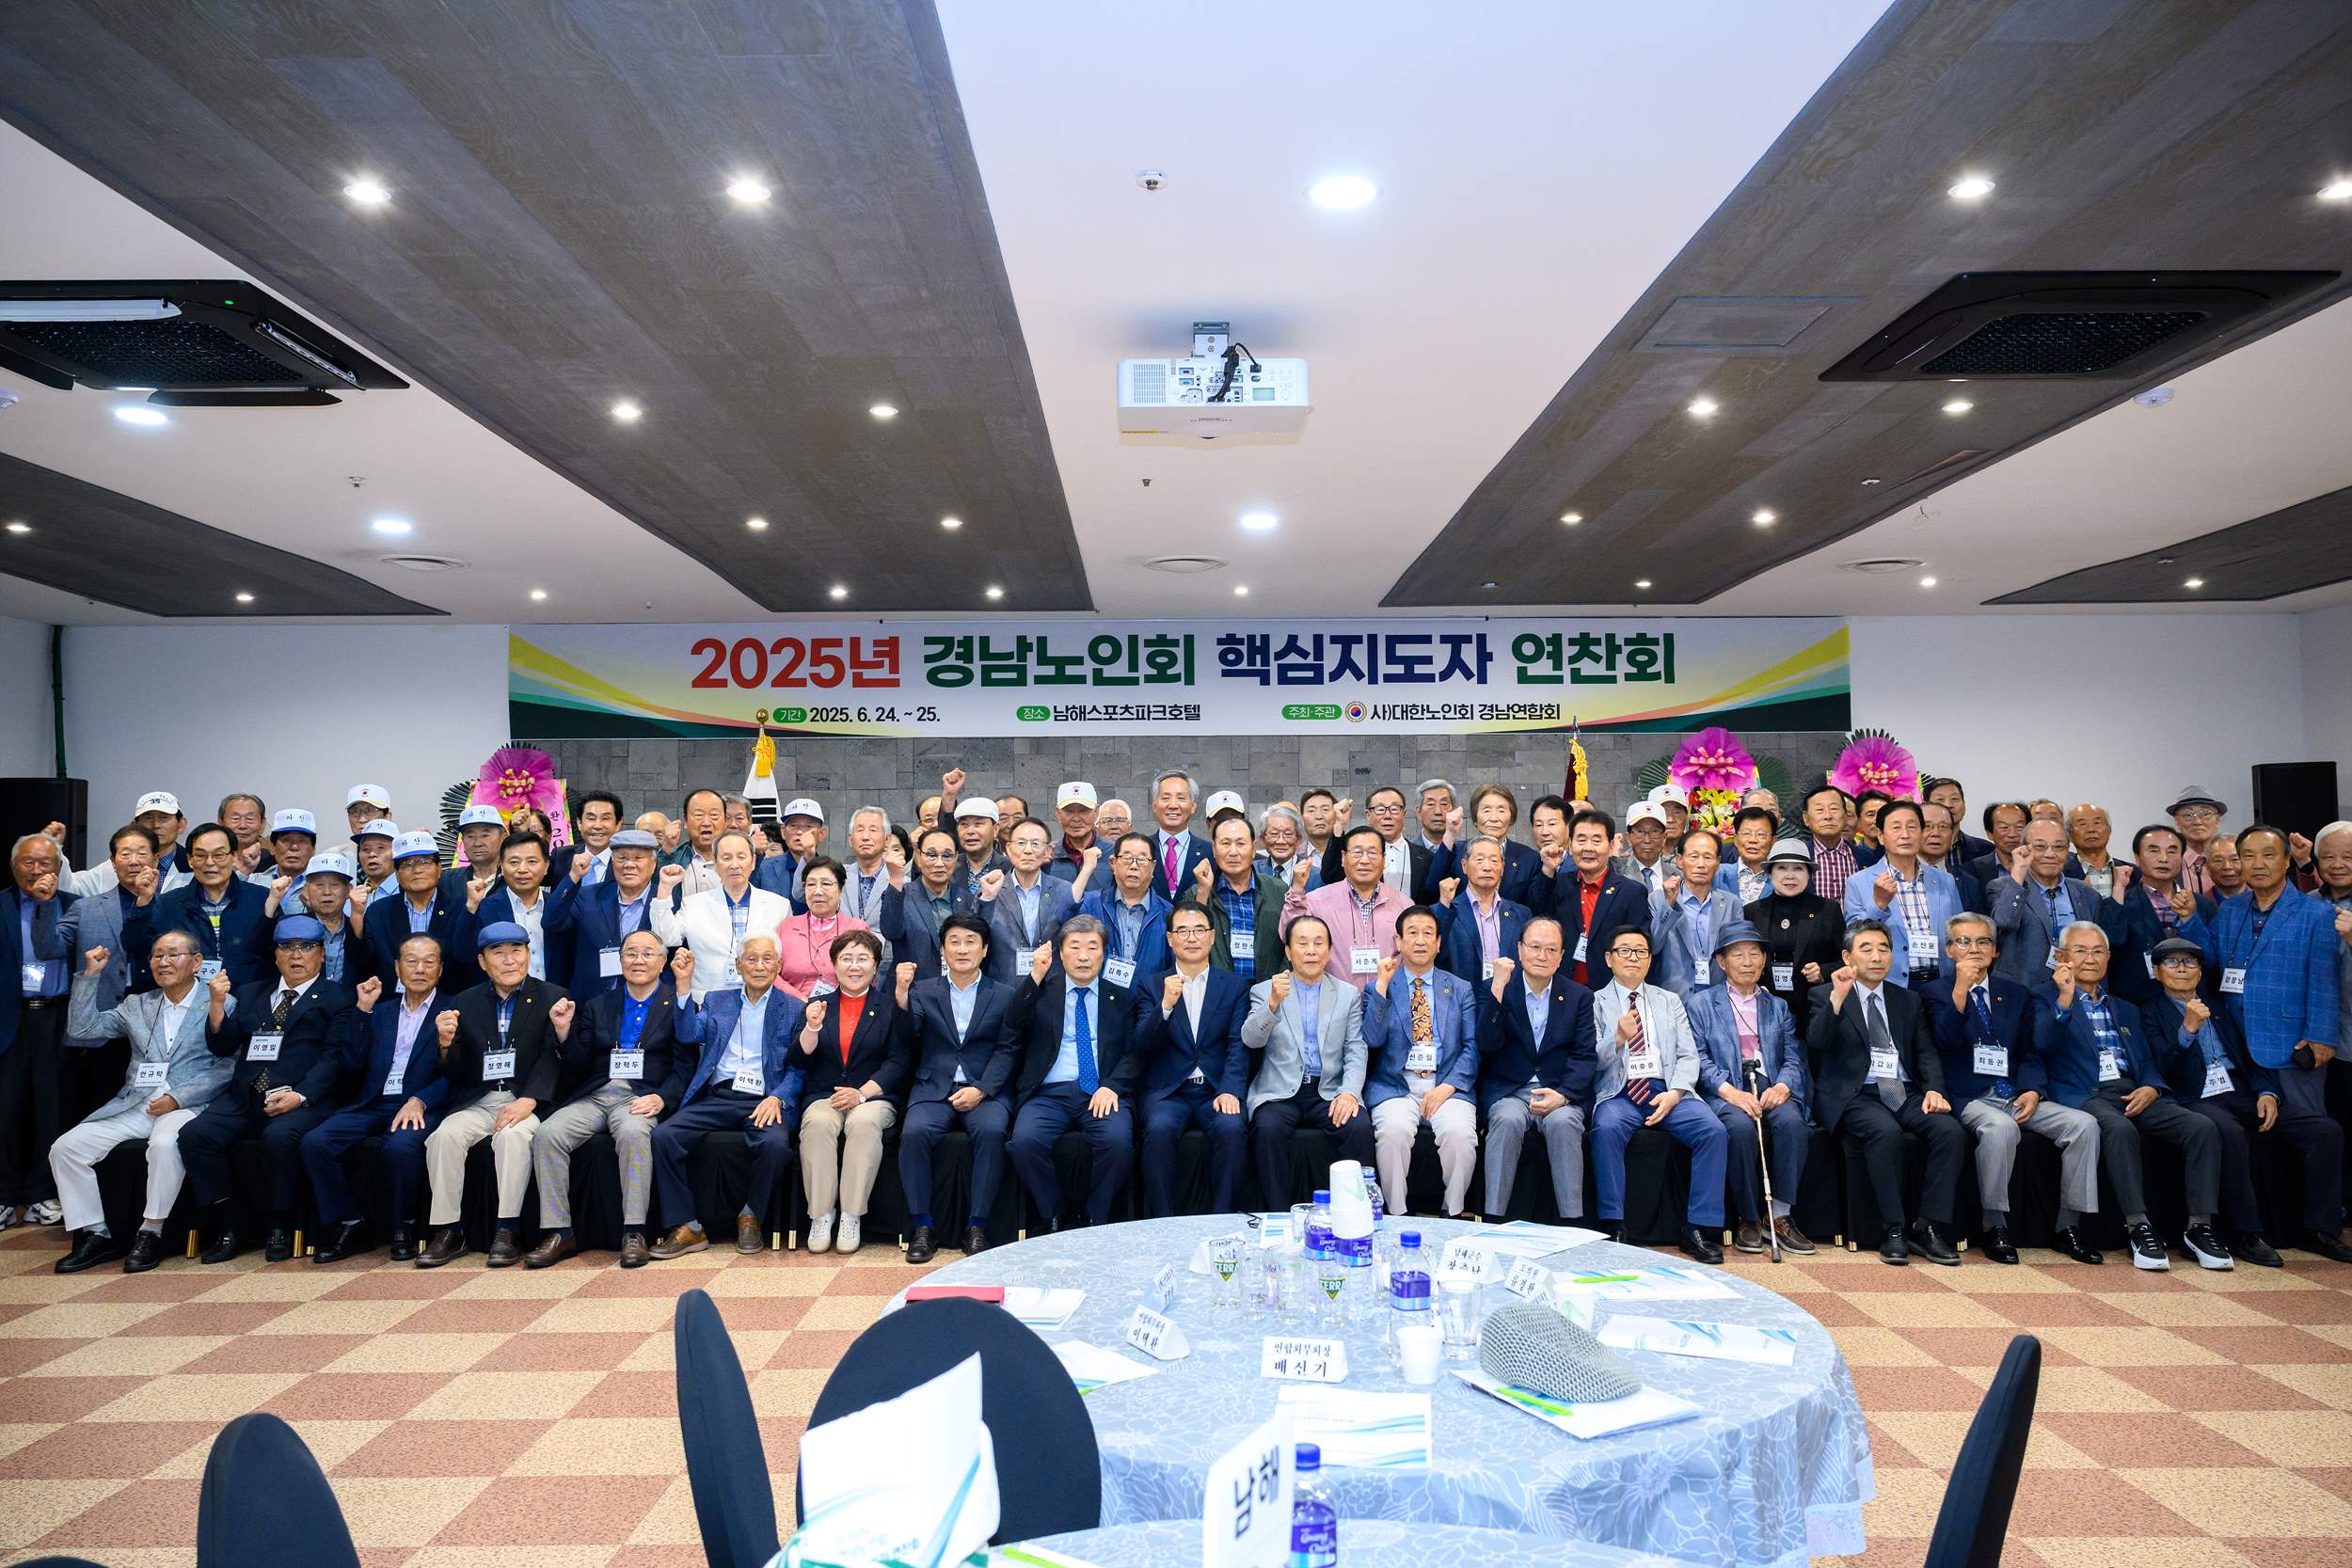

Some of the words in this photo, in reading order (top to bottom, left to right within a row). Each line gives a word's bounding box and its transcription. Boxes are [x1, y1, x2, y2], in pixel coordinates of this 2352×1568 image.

[691, 636, 900, 689] 2025년
[923, 634, 1195, 688] 경남노인회
[1216, 633, 1493, 687] 핵심지도자
[1512, 632, 1675, 686] 연찬회
[780, 709, 801, 721] 기간
[810, 707, 852, 722] 2025.
[857, 707, 871, 722] 6.
[1023, 707, 1044, 720] 장소
[1053, 705, 1201, 721] 남해스포츠파크호텔
[1370, 704, 1473, 721] 사)대한노인회
[1478, 704, 1561, 721] 경남연합회
[1274, 1359, 1327, 1378] 배신기
[1233, 1444, 1279, 1541] 남해
